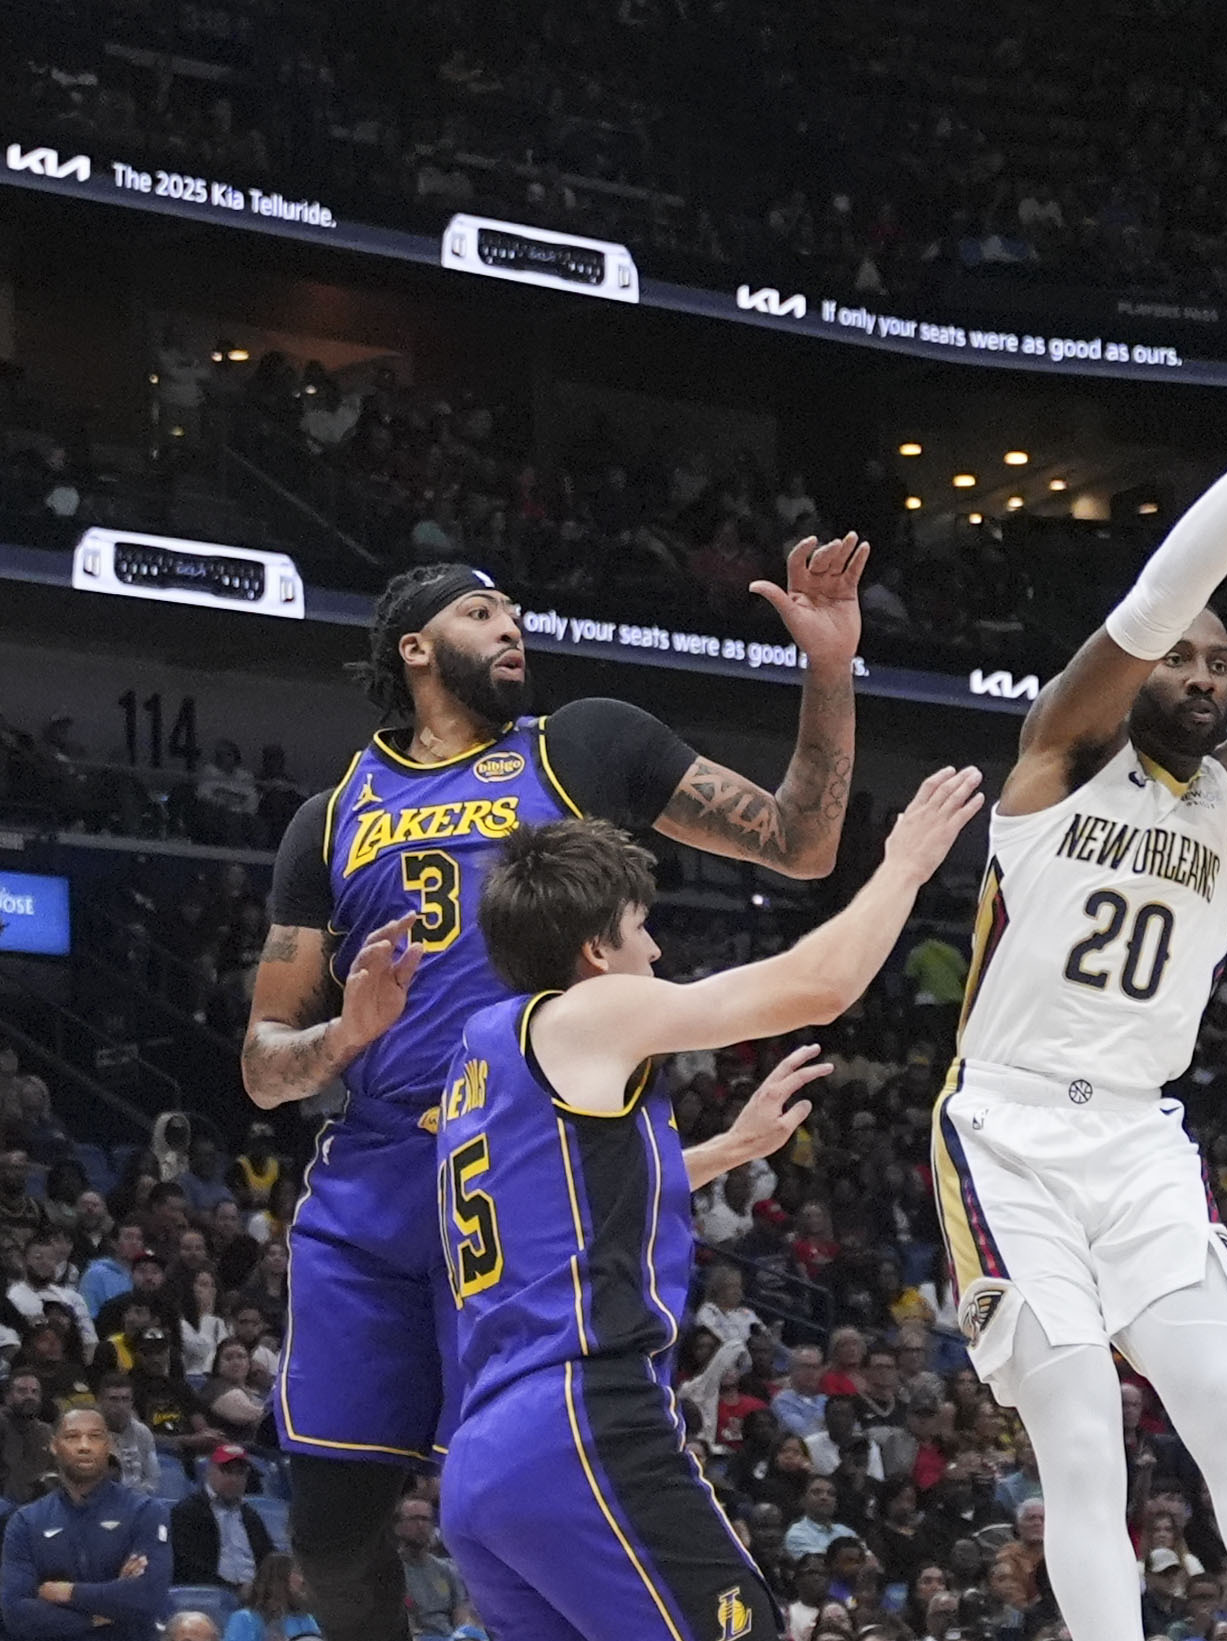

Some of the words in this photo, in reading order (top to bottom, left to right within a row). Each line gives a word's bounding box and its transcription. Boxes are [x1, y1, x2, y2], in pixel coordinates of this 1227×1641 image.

[113, 161, 151, 193] The
[155, 170, 207, 204] 2025
[211, 181, 244, 211] Kia
[249, 188, 337, 229] Telluride.
[822, 299, 836, 323] If
[838, 305, 875, 334] only
[877, 314, 917, 340] your
[919, 321, 966, 347] seats
[969, 328, 1019, 353] were
[1022, 335, 1046, 355] as
[1049, 338, 1101, 362] good
[1105, 341, 1129, 363] as
[1133, 343, 1182, 367] ours.
[524, 609, 568, 642] only
[570, 617, 617, 644] your
[619, 624, 670, 651] seats
[672, 631, 720, 657] were
[722, 639, 745, 661] as
[747, 640, 796, 669] good
[118, 690, 200, 771] 114
[478, 758, 521, 774] bibigo
[343, 796, 520, 879] LAKERS
[1056, 813, 1138, 871] NEW
[1132, 827, 1220, 904] ORLEANS
[0, 894, 34, 915] OSE
[401, 849, 461, 954] 3
[1063, 887, 1175, 1002] 20
